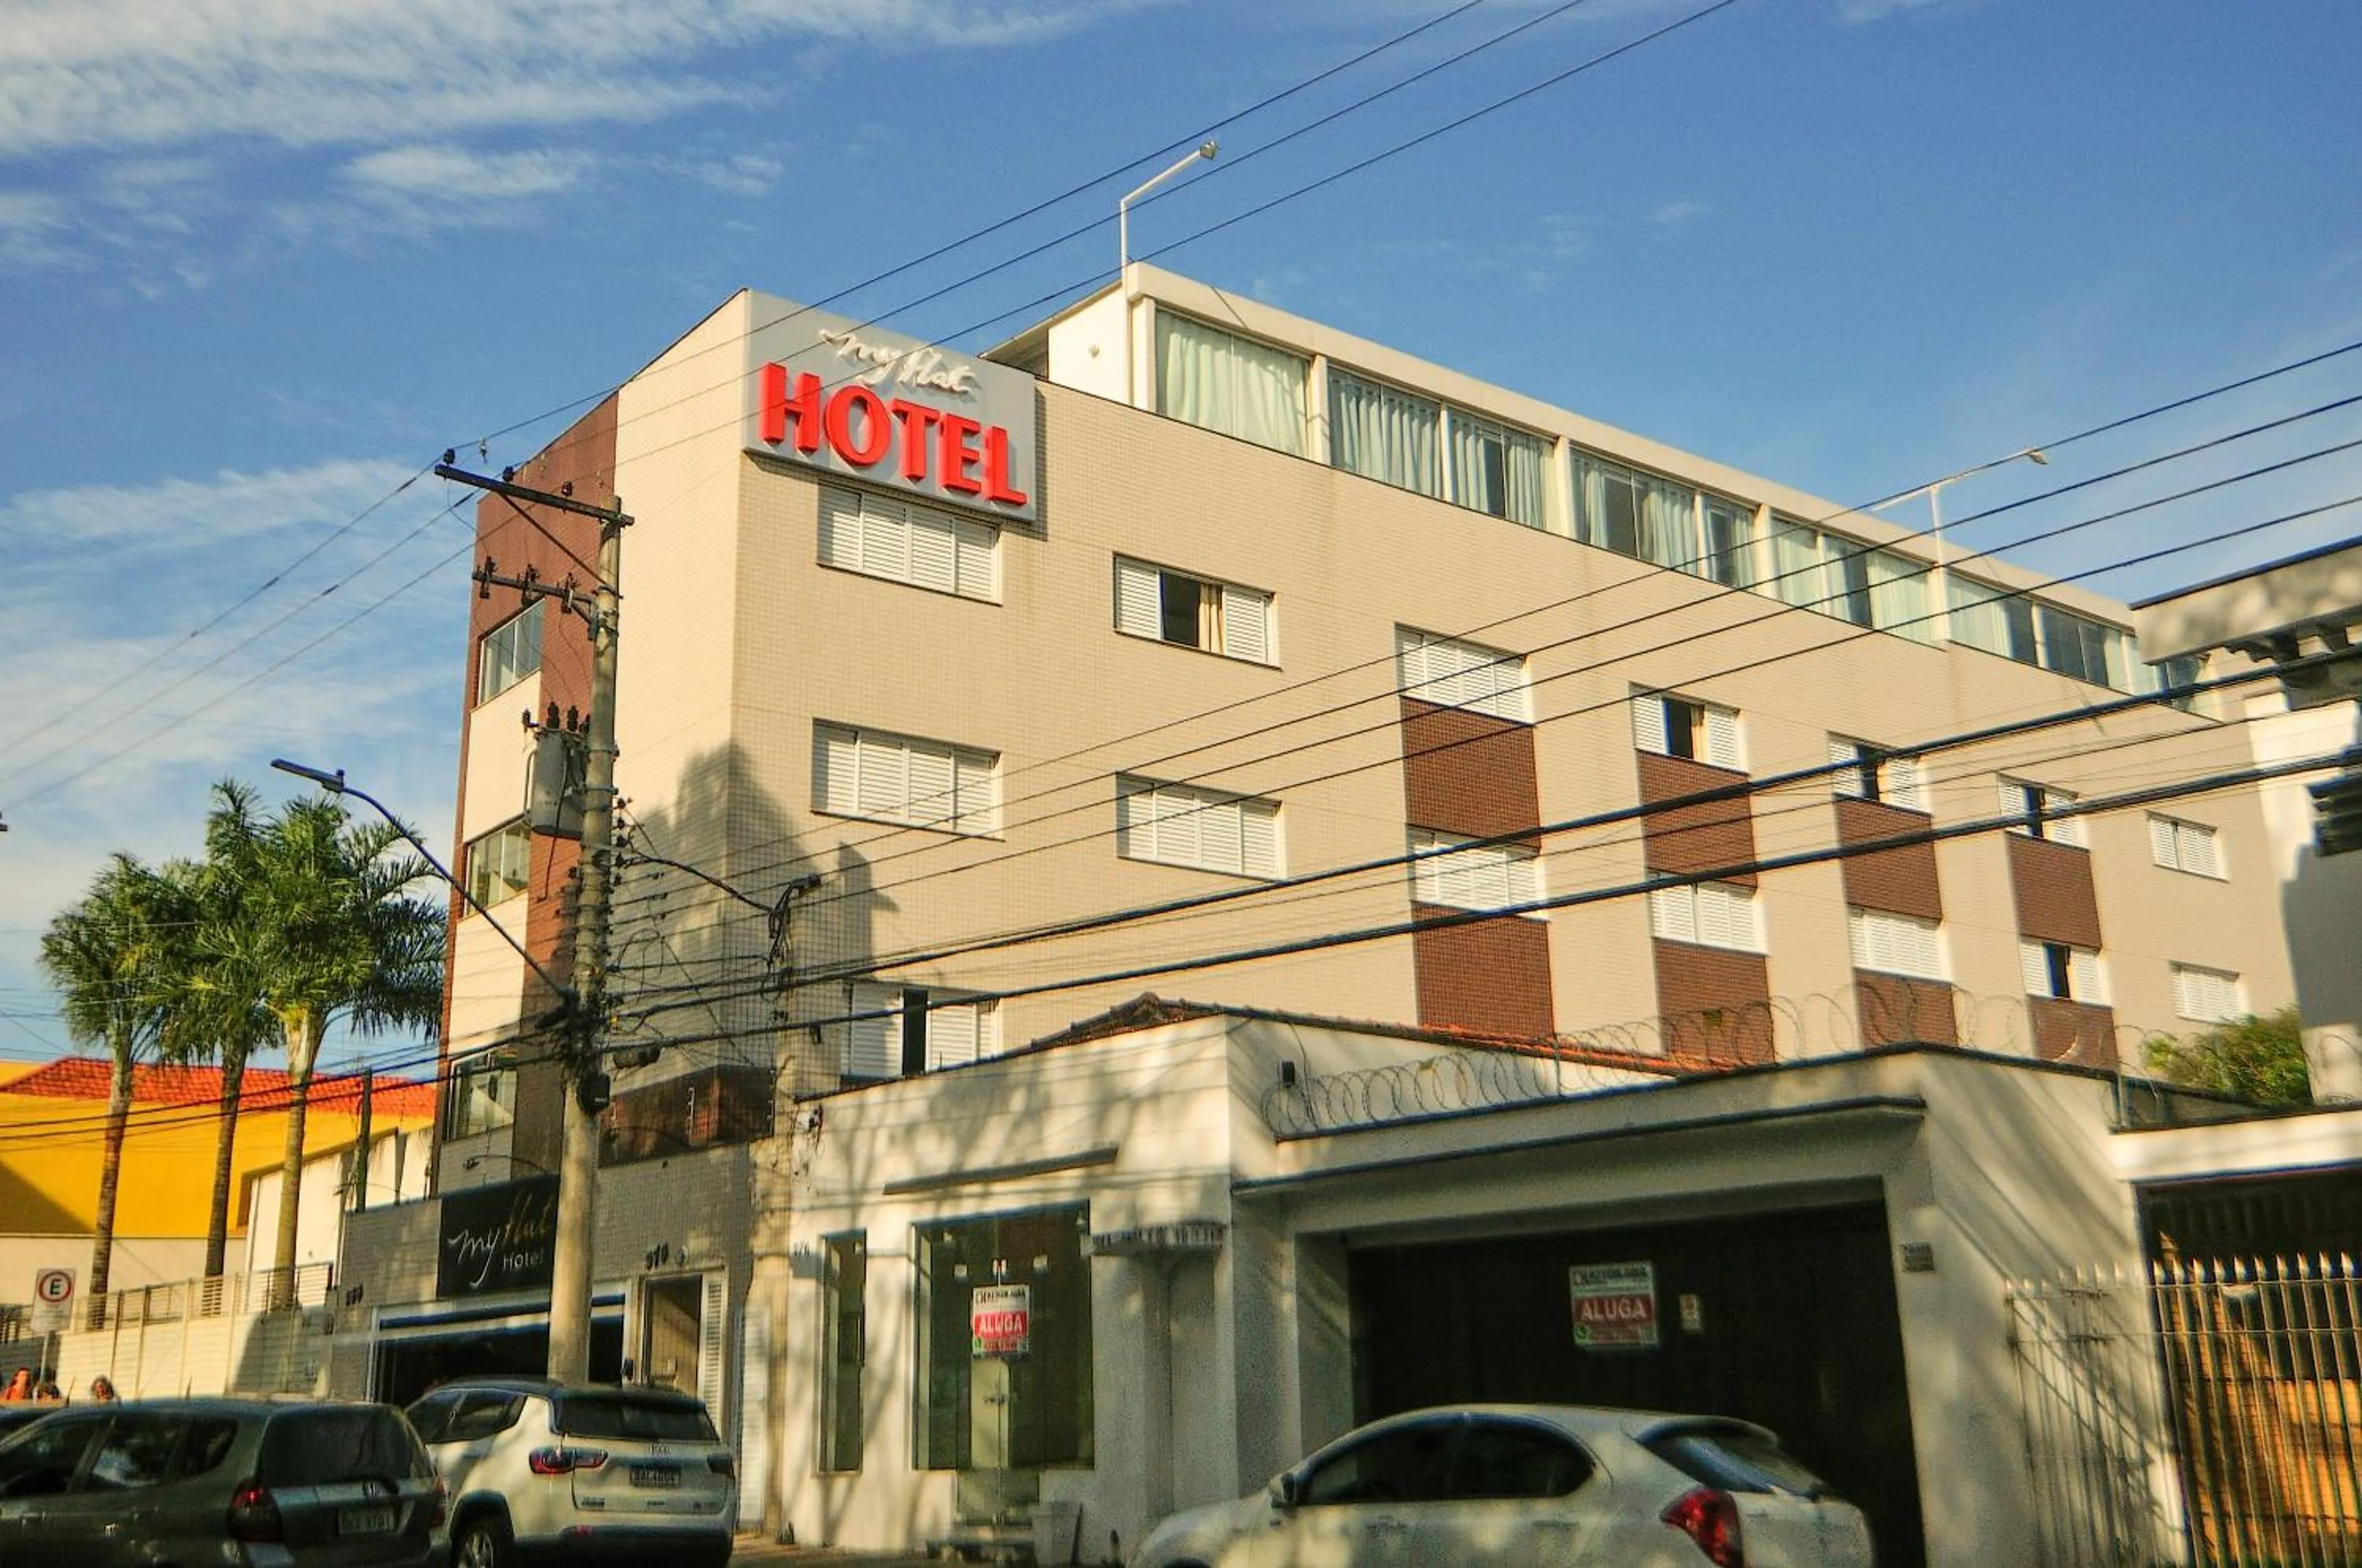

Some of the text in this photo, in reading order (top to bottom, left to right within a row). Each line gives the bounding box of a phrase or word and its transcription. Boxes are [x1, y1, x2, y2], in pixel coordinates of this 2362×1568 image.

[760, 361, 1027, 506] HOTEL
[50, 1278, 62, 1295] E
[1580, 1297, 1646, 1321] ALUGA
[979, 1312, 1023, 1334] ALUGA
